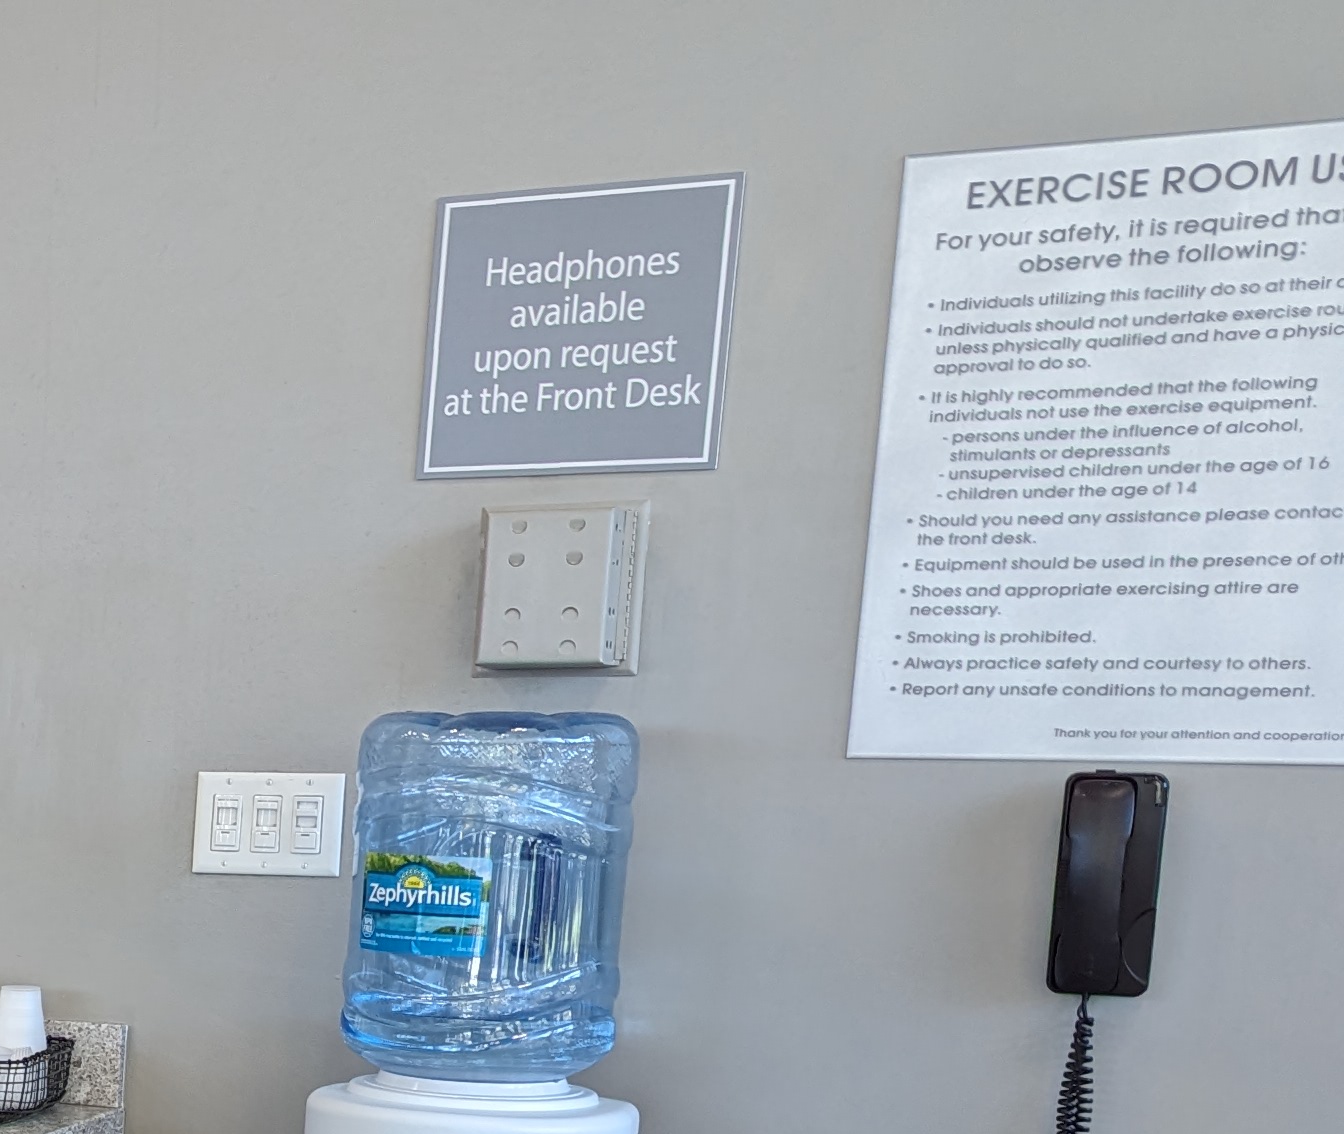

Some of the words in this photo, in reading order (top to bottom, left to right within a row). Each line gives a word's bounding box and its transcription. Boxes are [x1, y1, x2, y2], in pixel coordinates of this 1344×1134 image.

[966, 168, 1150, 210] EXERCISE
[1161, 156, 1299, 196] ROOM
[1311, 152, 1344, 185] U
[935, 232, 973, 251] For
[978, 230, 1034, 252] your
[1038, 221, 1120, 245] safety,
[1128, 219, 1145, 238] it
[1149, 218, 1168, 237] is
[1173, 208, 1290, 236] required
[1295, 206, 1344, 226] tha
[485, 249, 680, 289] Headphones
[1018, 253, 1123, 274] observe
[1128, 247, 1171, 267] the
[1177, 239, 1307, 264] following:
[940, 294, 1035, 312] Individuals
[1038, 291, 1106, 307] utilizing
[1110, 288, 1140, 303] this
[1144, 284, 1207, 300] facility
[1210, 282, 1237, 297] do
[1239, 282, 1262, 295] so
[1264, 278, 1286, 294] at
[1289, 276, 1333, 292] their
[510, 291, 645, 328] available
[937, 319, 1032, 337] Individuals
[1035, 316, 1095, 333] should
[1098, 314, 1129, 329] not
[1132, 309, 1229, 327] undertake
[1232, 304, 1313, 322] exercise
[935, 341, 989, 356] unless
[991, 336, 1082, 356] physically
[1085, 331, 1167, 351] qualified
[1170, 329, 1210, 345] and
[1213, 328, 1261, 342] have
[1265, 328, 1279, 340] a
[474, 346, 551, 378] upon
[561, 335, 678, 374] request
[933, 358, 1014, 377] approval
[1017, 357, 1036, 371] to
[1038, 356, 1064, 370] do
[1066, 357, 1092, 369] so.
[443, 389, 472, 416] at
[479, 384, 528, 414] the
[536, 380, 617, 412] Front
[625, 374, 702, 408] Desk
[931, 391, 942, 404] It
[945, 390, 958, 404] is
[961, 388, 1014, 406] highly
[1017, 382, 1154, 401] recommended
[1157, 380, 1194, 395] that
[1197, 379, 1228, 393] the
[1232, 375, 1319, 392] following
[929, 407, 1023, 423] individuals
[1026, 405, 1055, 420] not
[1059, 407, 1090, 419] use
[1093, 403, 1123, 417] the
[1126, 400, 1204, 416] exercise
[1207, 395, 1317, 414] equipment.
[951, 431, 1020, 446] persons
[1023, 427, 1076, 442] under
[1080, 426, 1109, 439] the
[1112, 424, 1200, 438] influence
[1202, 421, 1223, 435] of
[1225, 418, 1303, 435] alcohol,
[949, 447, 1036, 463] stimulants
[1039, 449, 1058, 460] or
[1061, 443, 1171, 461] depressants
[948, 464, 1065, 482] unsupervised
[1068, 463, 1143, 478] children
[1147, 460, 1202, 475] under
[1205, 459, 1236, 473] the
[1239, 459, 1278, 475] age
[1283, 457, 1303, 471] of
[1308, 456, 1330, 470] 16
[946, 486, 1019, 501] children
[1022, 485, 1075, 500] under
[1078, 484, 1107, 497] the
[1111, 485, 1149, 500] age
[1152, 481, 1172, 496] of
[1177, 480, 1198, 495] 14
[918, 513, 978, 528] Should
[981, 515, 1013, 529] you
[1017, 511, 1064, 526] need
[1067, 513, 1102, 526] any
[1105, 509, 1201, 524] assistance
[1205, 508, 1270, 524] please
[1274, 505, 1342, 520] contac
[917, 533, 945, 546] the
[948, 531, 988, 546] front
[991, 531, 1037, 545] desk.
[914, 557, 1008, 574] Equipment
[1010, 556, 1070, 570] should
[1073, 556, 1098, 570] be
[1101, 555, 1145, 569] used
[1149, 555, 1165, 568] in
[1169, 554, 1199, 568] the
[1202, 555, 1293, 570] presence
[1296, 552, 1317, 566] of
[911, 584, 962, 598] Shoes
[965, 583, 1001, 597] and
[1004, 582, 1113, 599] appropriate
[1116, 581, 1210, 598] exercising
[1214, 581, 1263, 595] attire
[1266, 582, 1299, 594] are
[909, 605, 1002, 618] necessary.
[906, 630, 981, 647] Smoking
[983, 630, 996, 644] is
[999, 630, 1096, 646] prohibited.
[903, 656, 963, 672] Always
[966, 656, 1042, 672] practice
[1045, 656, 1099, 672] safety
[1102, 657, 1139, 670] and
[1143, 657, 1222, 672] courtesy
[1226, 657, 1245, 670] to
[1248, 656, 1311, 670] others.
[901, 682, 959, 698] Report
[962, 685, 996, 698] any
[999, 683, 1058, 696] unsafe
[1062, 683, 1156, 697] conditions
[1159, 683, 1178, 697] to
[1181, 684, 1315, 701] management.
[1054, 728, 1091, 738] Thank
[1093, 730, 1118, 740] you
[1120, 729, 1138, 739] for
[1139, 730, 1169, 741] your
[1170, 729, 1230, 740] attention
[1233, 730, 1261, 740] and
[368, 882, 472, 907] Zephyrhills
